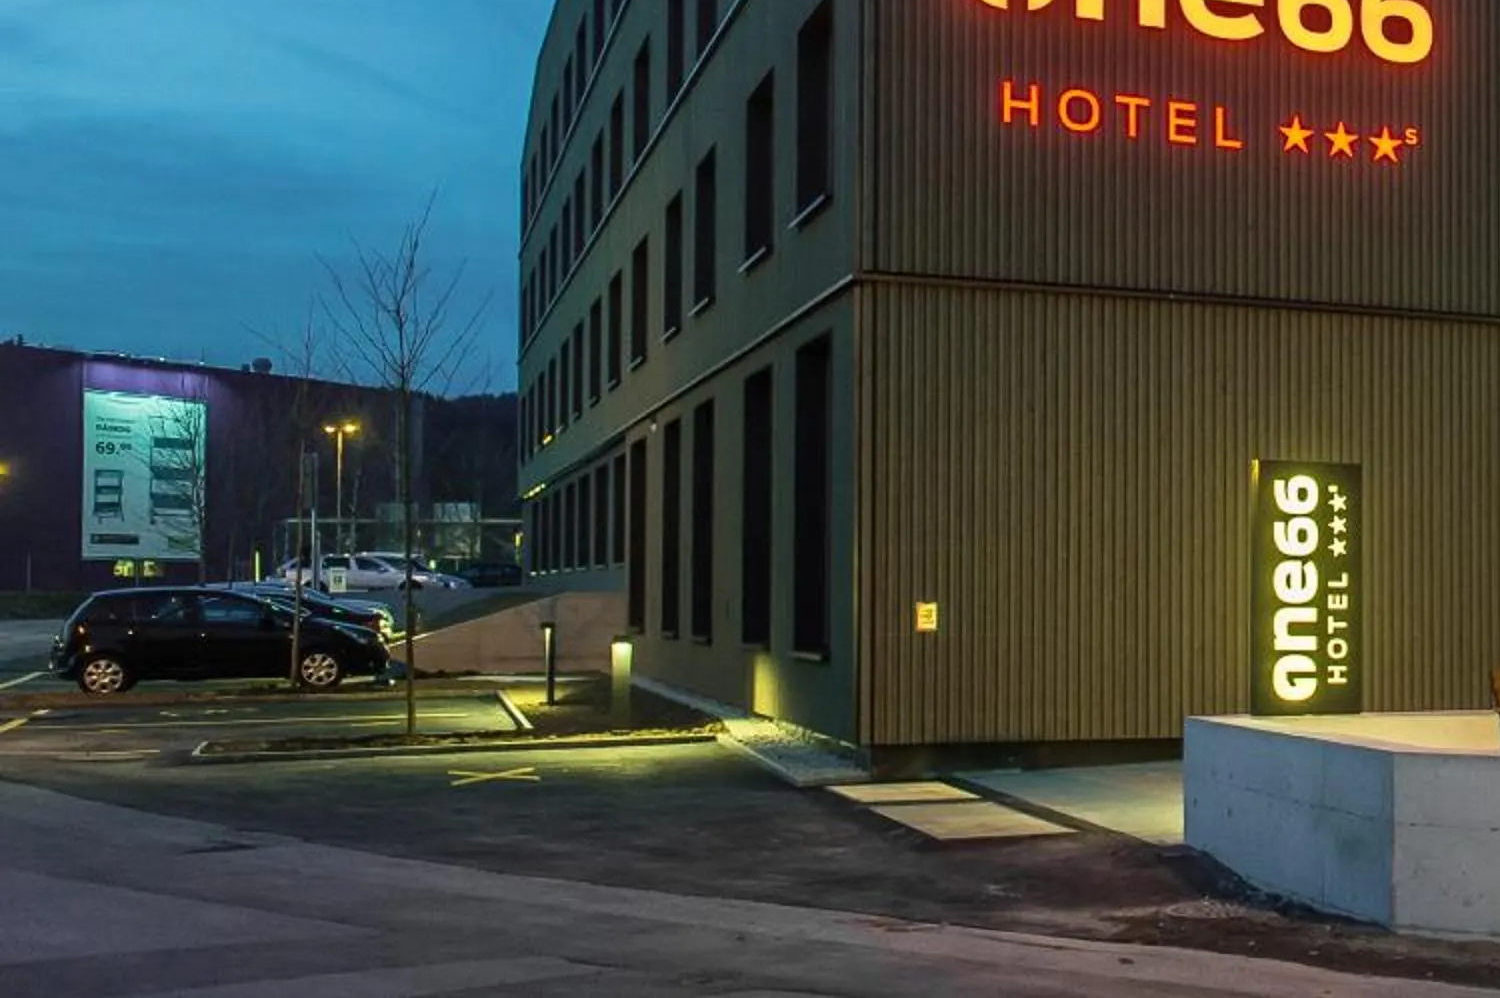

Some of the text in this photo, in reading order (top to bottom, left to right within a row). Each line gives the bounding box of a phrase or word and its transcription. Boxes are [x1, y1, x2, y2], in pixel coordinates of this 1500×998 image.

[1003, 82, 1243, 149] HOTEL
[1273, 474, 1318, 701] one66
[1327, 572, 1348, 684] HOTEL
